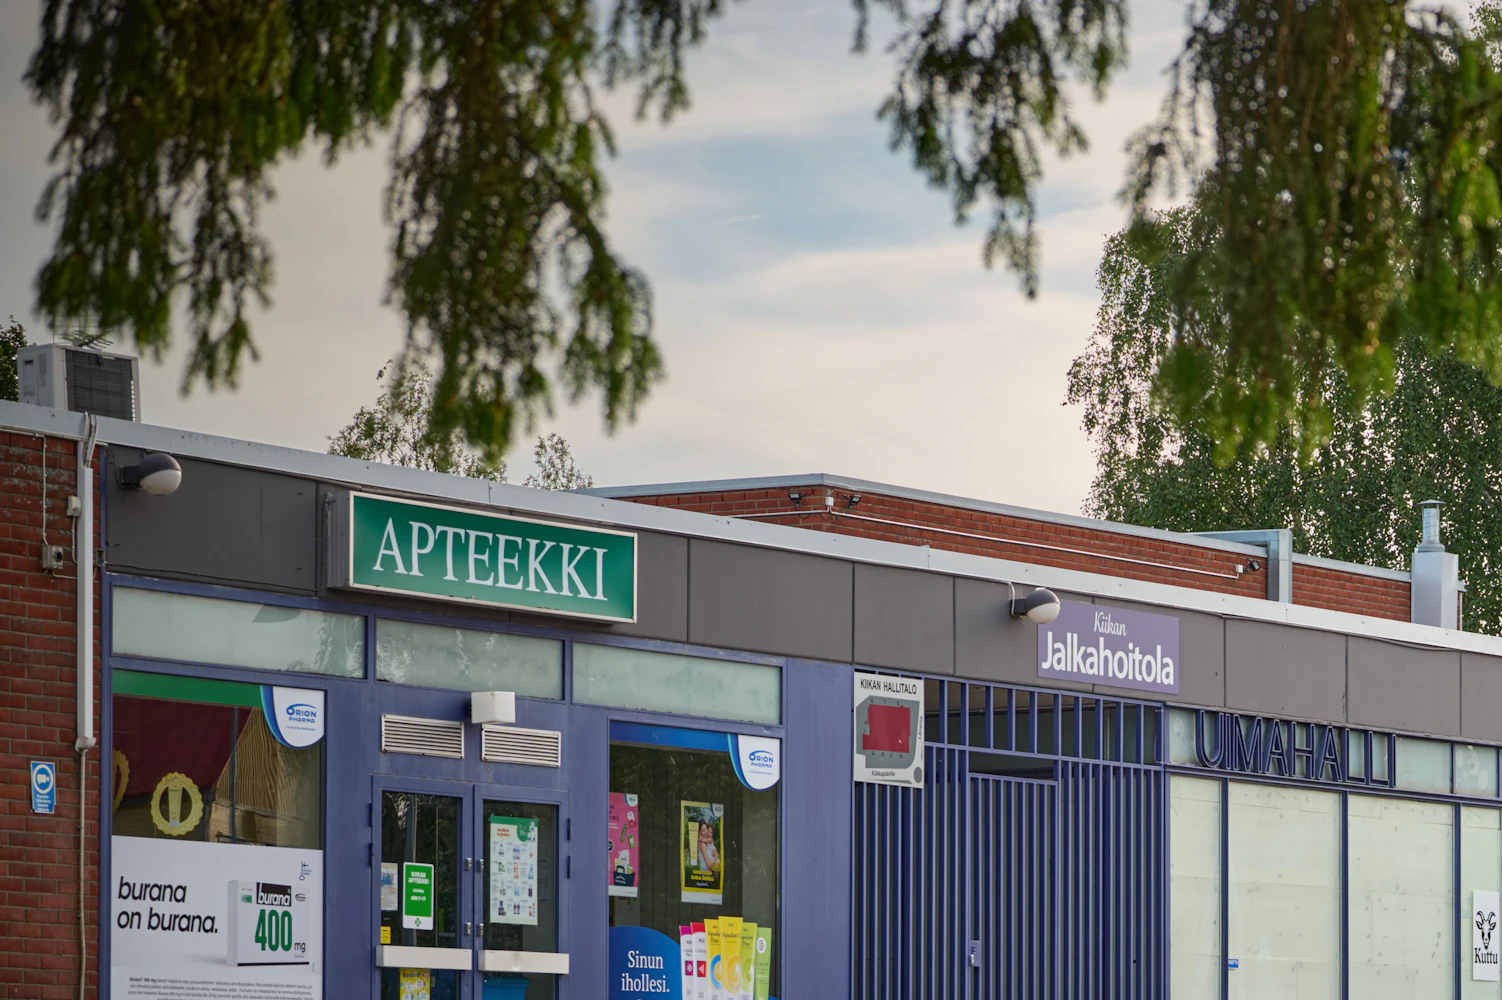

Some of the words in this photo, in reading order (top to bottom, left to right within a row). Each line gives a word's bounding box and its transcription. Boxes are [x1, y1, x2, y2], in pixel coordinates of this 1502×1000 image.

[373, 517, 608, 601] APTEEKKI
[1094, 611, 1127, 636] Kiikan
[1042, 631, 1174, 685] Jalkahoitola
[860, 678, 881, 690] KIIKAN
[883, 681, 917, 694] HALLITALO
[286, 704, 317, 717] ORION
[749, 750, 774, 763] ORION
[1195, 709, 1396, 788] UIMAHALLI
[118, 876, 187, 903] burana
[258, 882, 291, 906] burana
[117, 910, 141, 929] on
[147, 906, 218, 934] burana.
[255, 909, 292, 952] 400
[294, 942, 306, 952] mg
[1474, 947, 1498, 964] Kuttu
[627, 950, 664, 969] Sinun
[621, 973, 670, 993] ihollesi.
